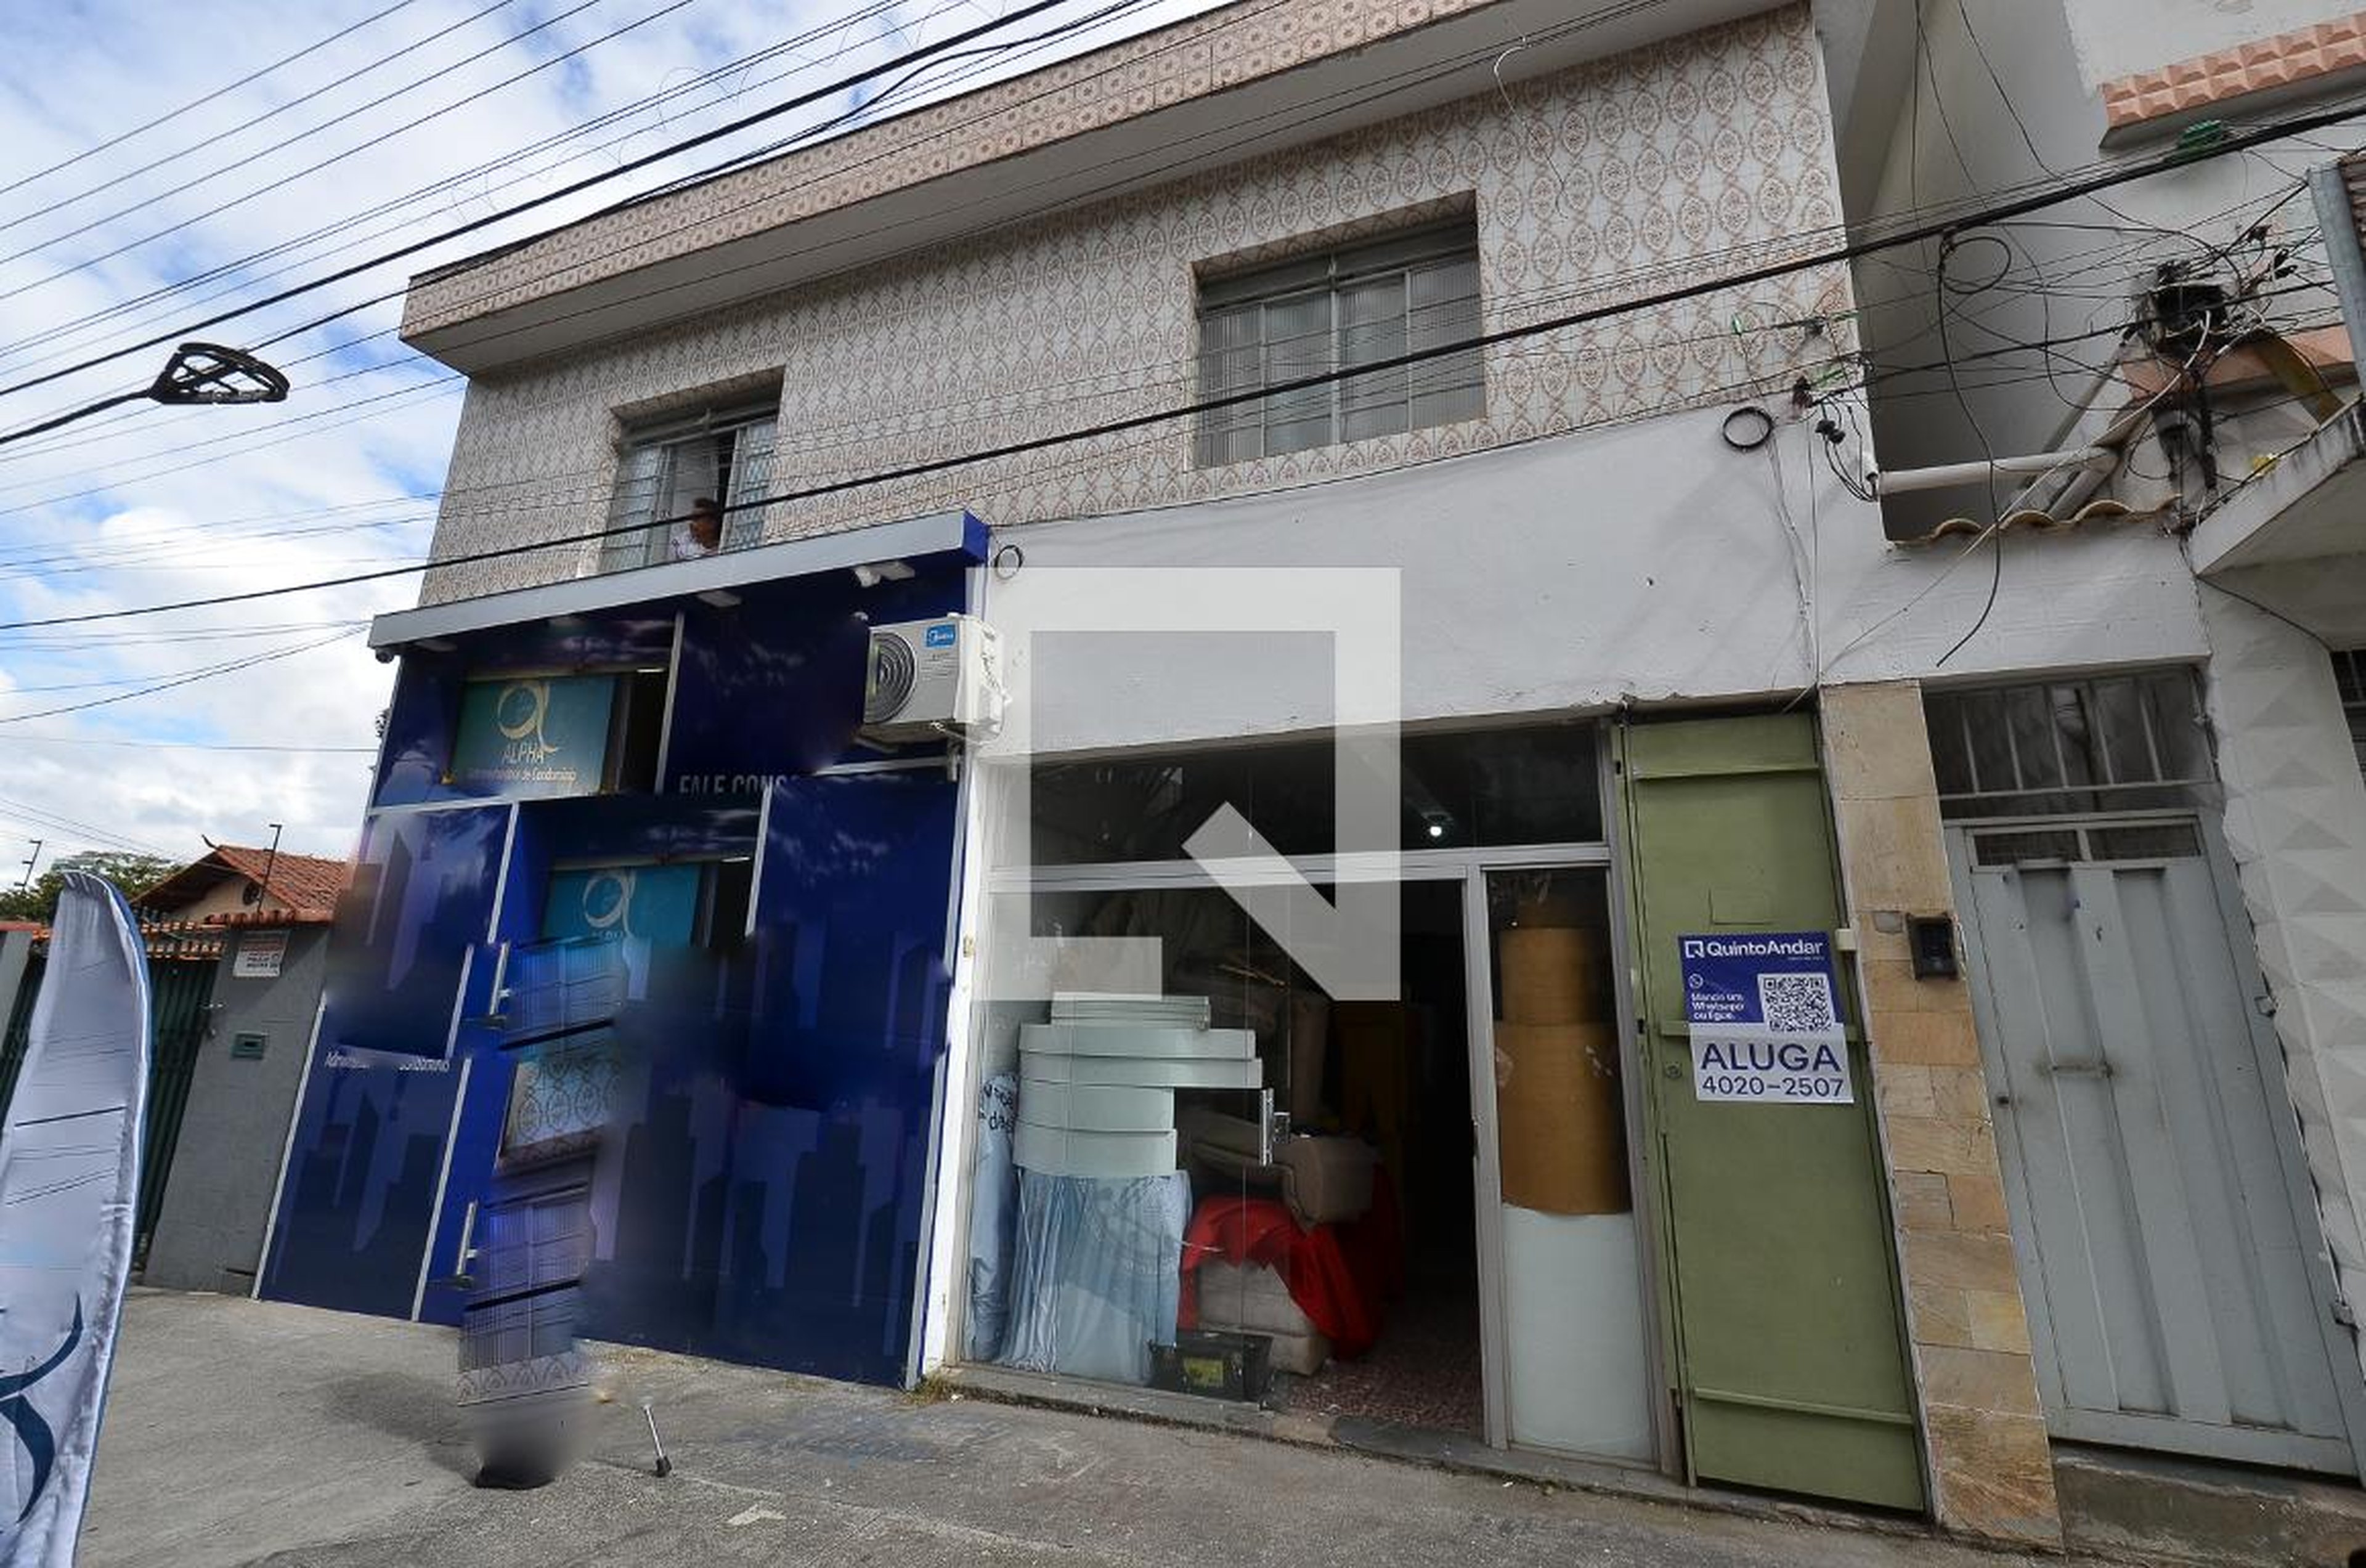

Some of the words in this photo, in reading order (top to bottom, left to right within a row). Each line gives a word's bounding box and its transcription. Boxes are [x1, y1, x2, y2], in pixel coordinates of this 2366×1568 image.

[501, 741, 545, 765] ALPHA
[1707, 940, 1823, 956] QuintoAndar
[1701, 1043, 1842, 1072] ALUGA
[1702, 1076, 1844, 1097] 4020-2507
